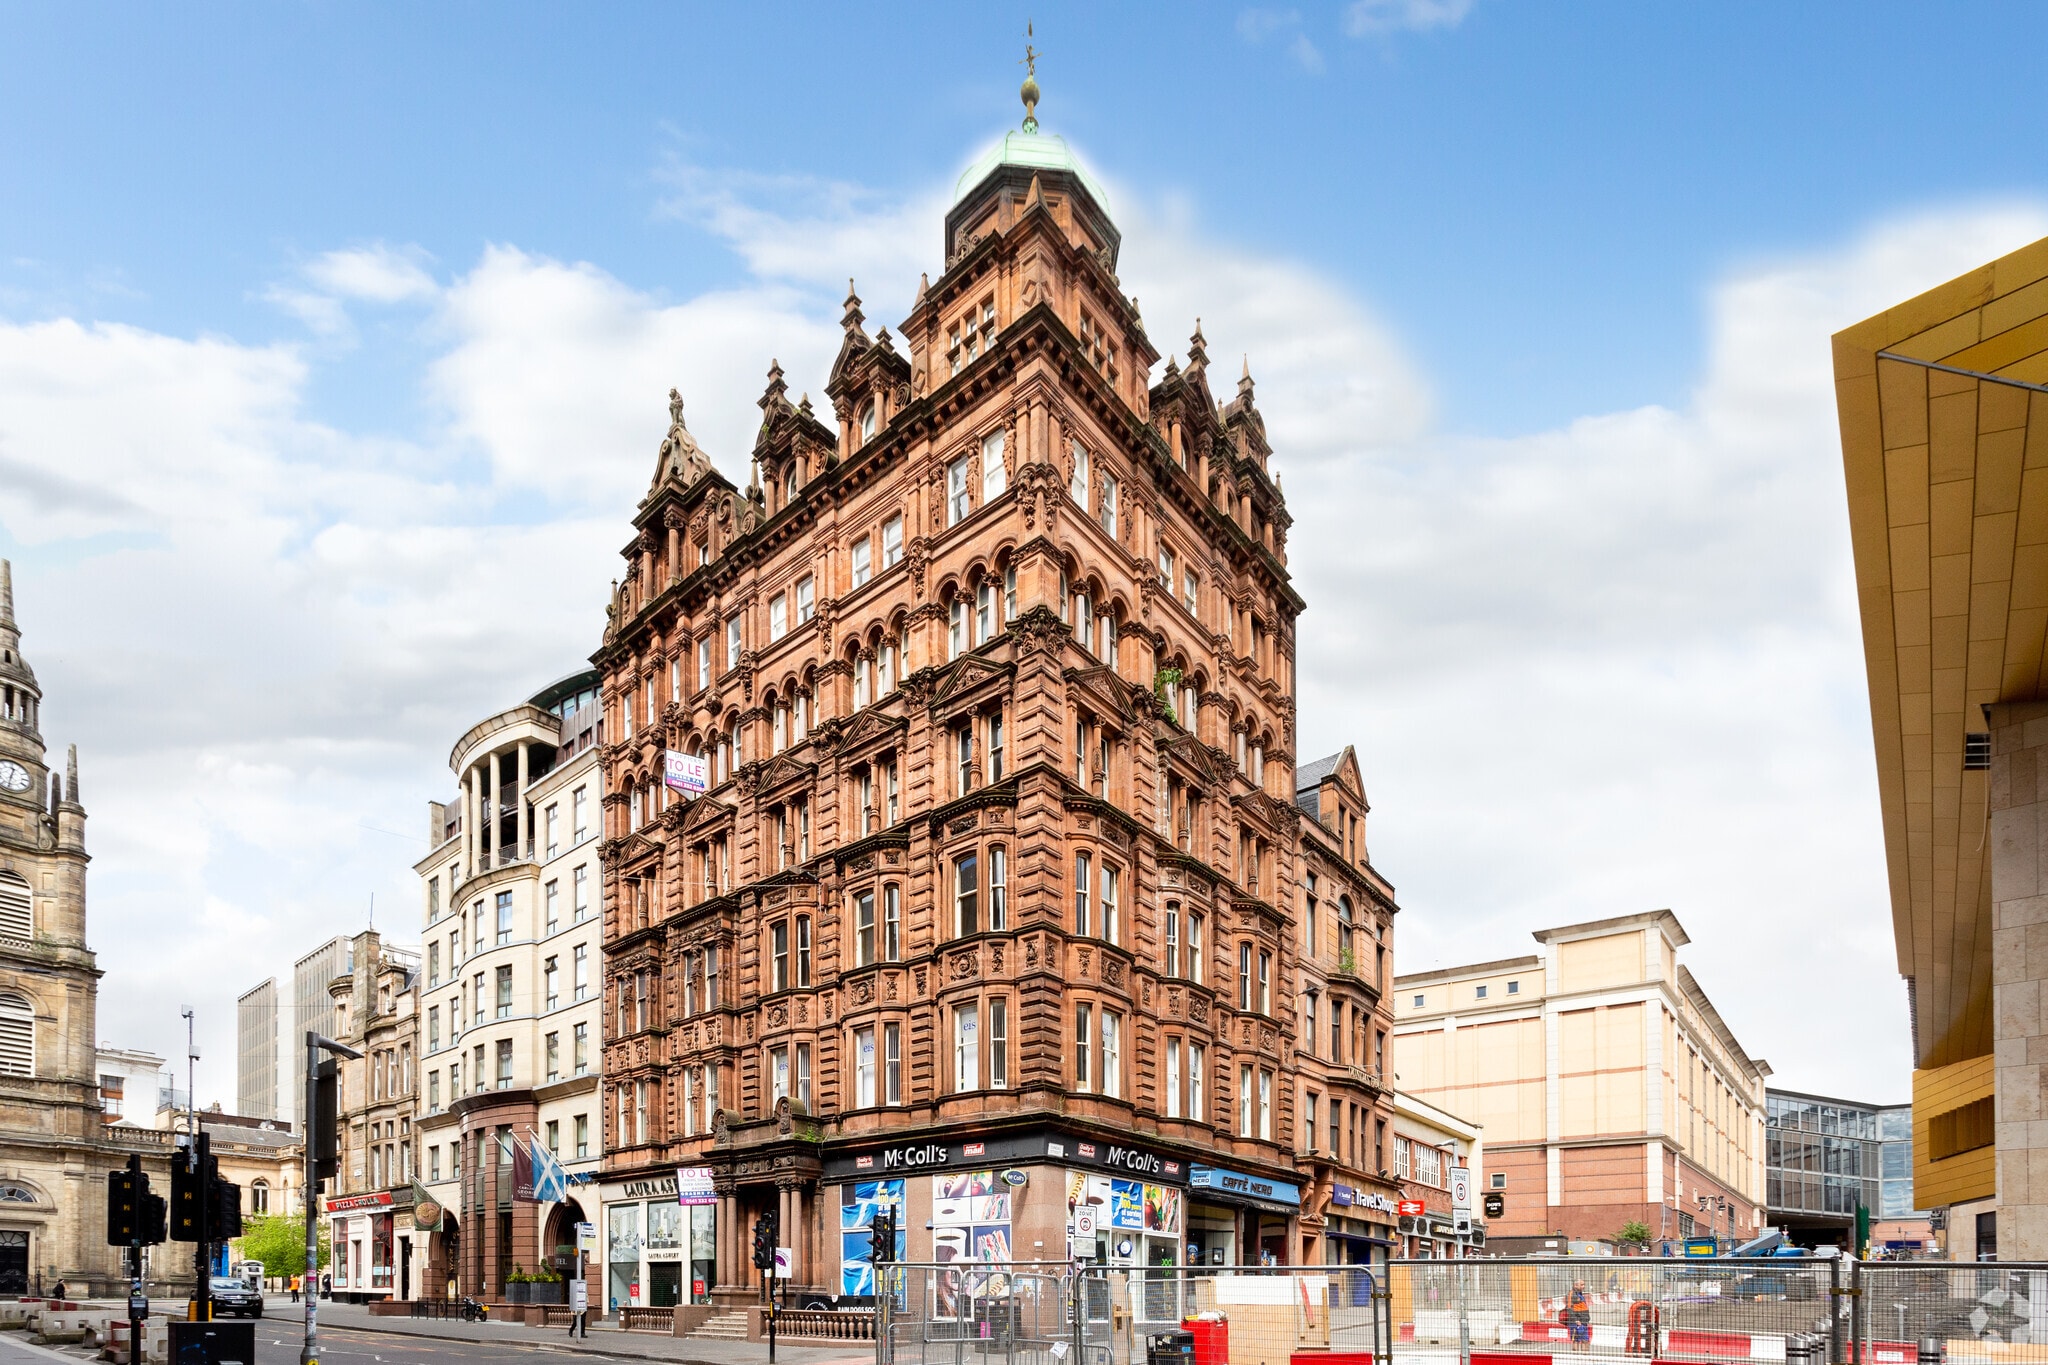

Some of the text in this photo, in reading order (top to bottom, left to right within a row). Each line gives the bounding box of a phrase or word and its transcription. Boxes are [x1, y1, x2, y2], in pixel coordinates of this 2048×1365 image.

[668, 758, 705, 777] TO LE
[965, 1145, 982, 1155] mail
[884, 1145, 947, 1168] McColl's
[1107, 1146, 1160, 1173] McColl's
[679, 1169, 696, 1178] TO
[1008, 1174, 1024, 1182] McColl's
[623, 1179, 659, 1197] LAURA
[1250, 1182, 1272, 1196] NERO
[336, 1197, 380, 1209] PIZZA CROLLA
[878, 1195, 888, 1203] 100
[1121, 1199, 1131, 1209] 100
[1355, 1187, 1394, 1216] Travel Shop
[1121, 1217, 1141, 1226] Scotland
